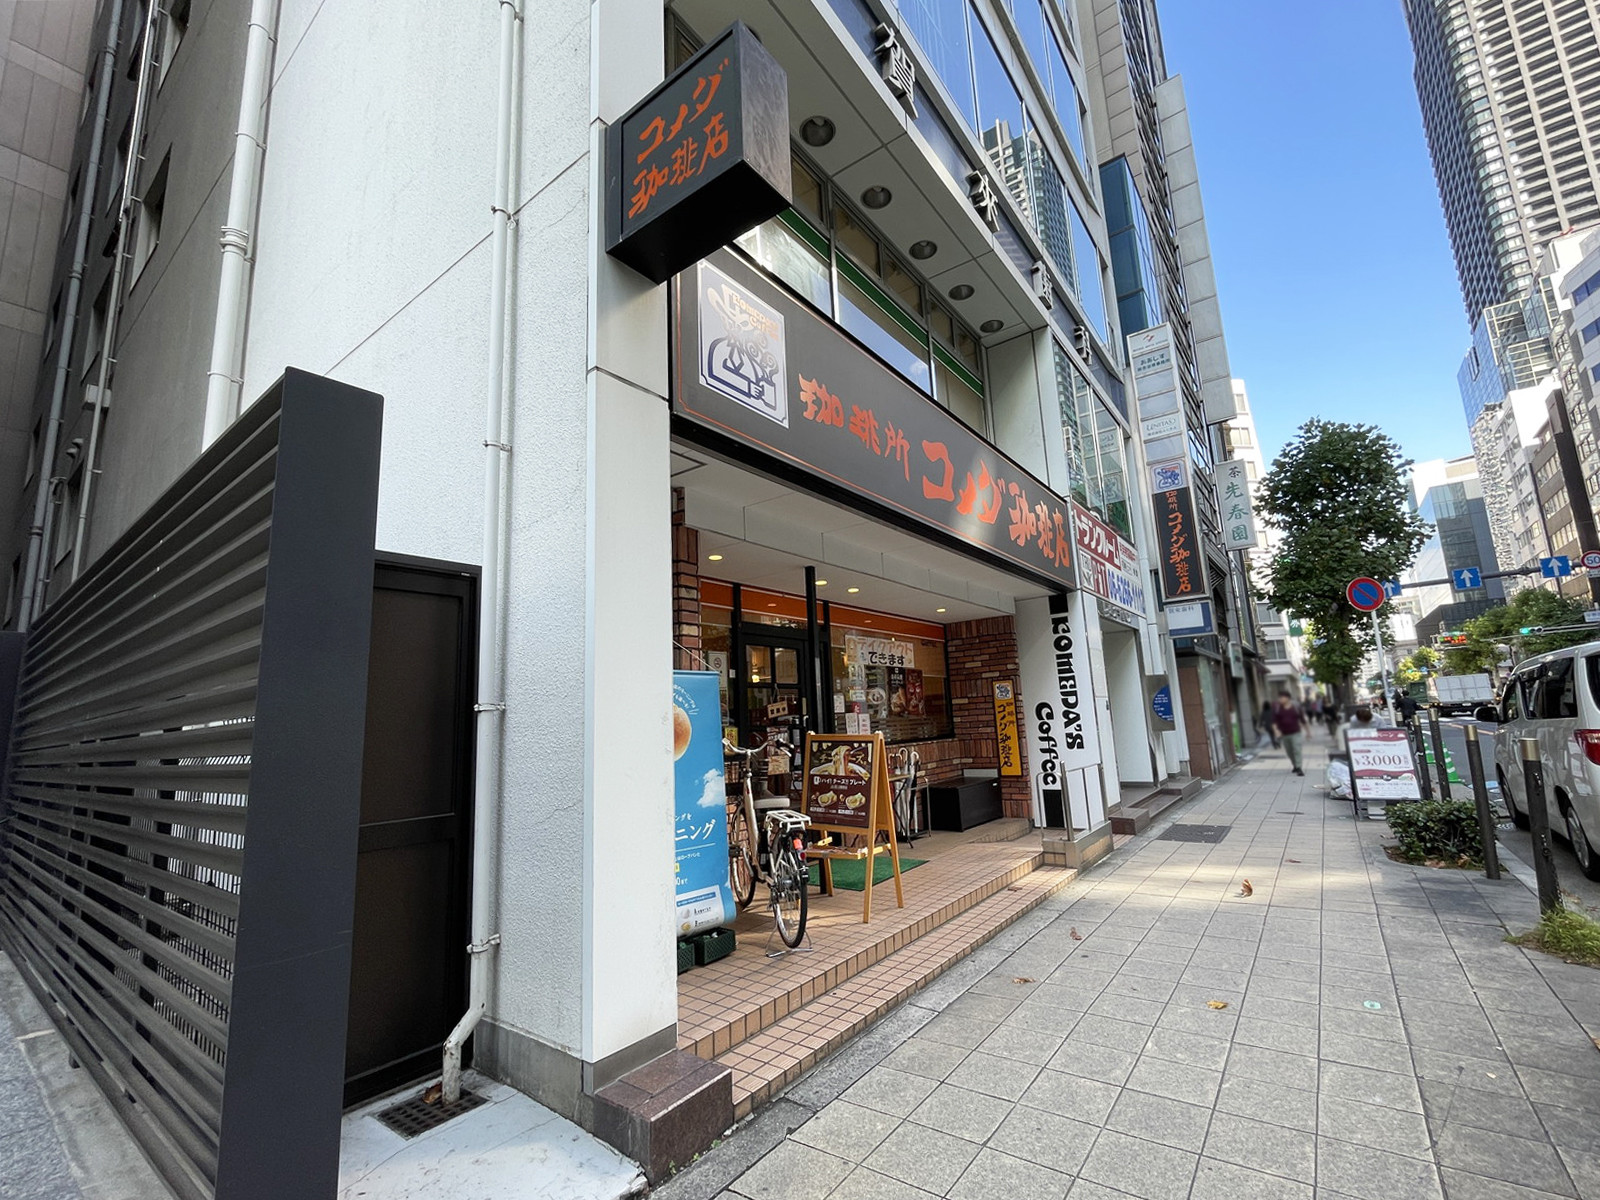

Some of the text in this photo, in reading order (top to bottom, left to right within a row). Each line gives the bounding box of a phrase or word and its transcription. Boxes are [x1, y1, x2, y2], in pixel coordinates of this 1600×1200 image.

[637, 57, 729, 164] コメダ
[628, 112, 728, 219] 珈琲店
[1586, 555, 1600, 565] 50
[868, 651, 905, 666] できます
[1035, 701, 1059, 786] Coffee
